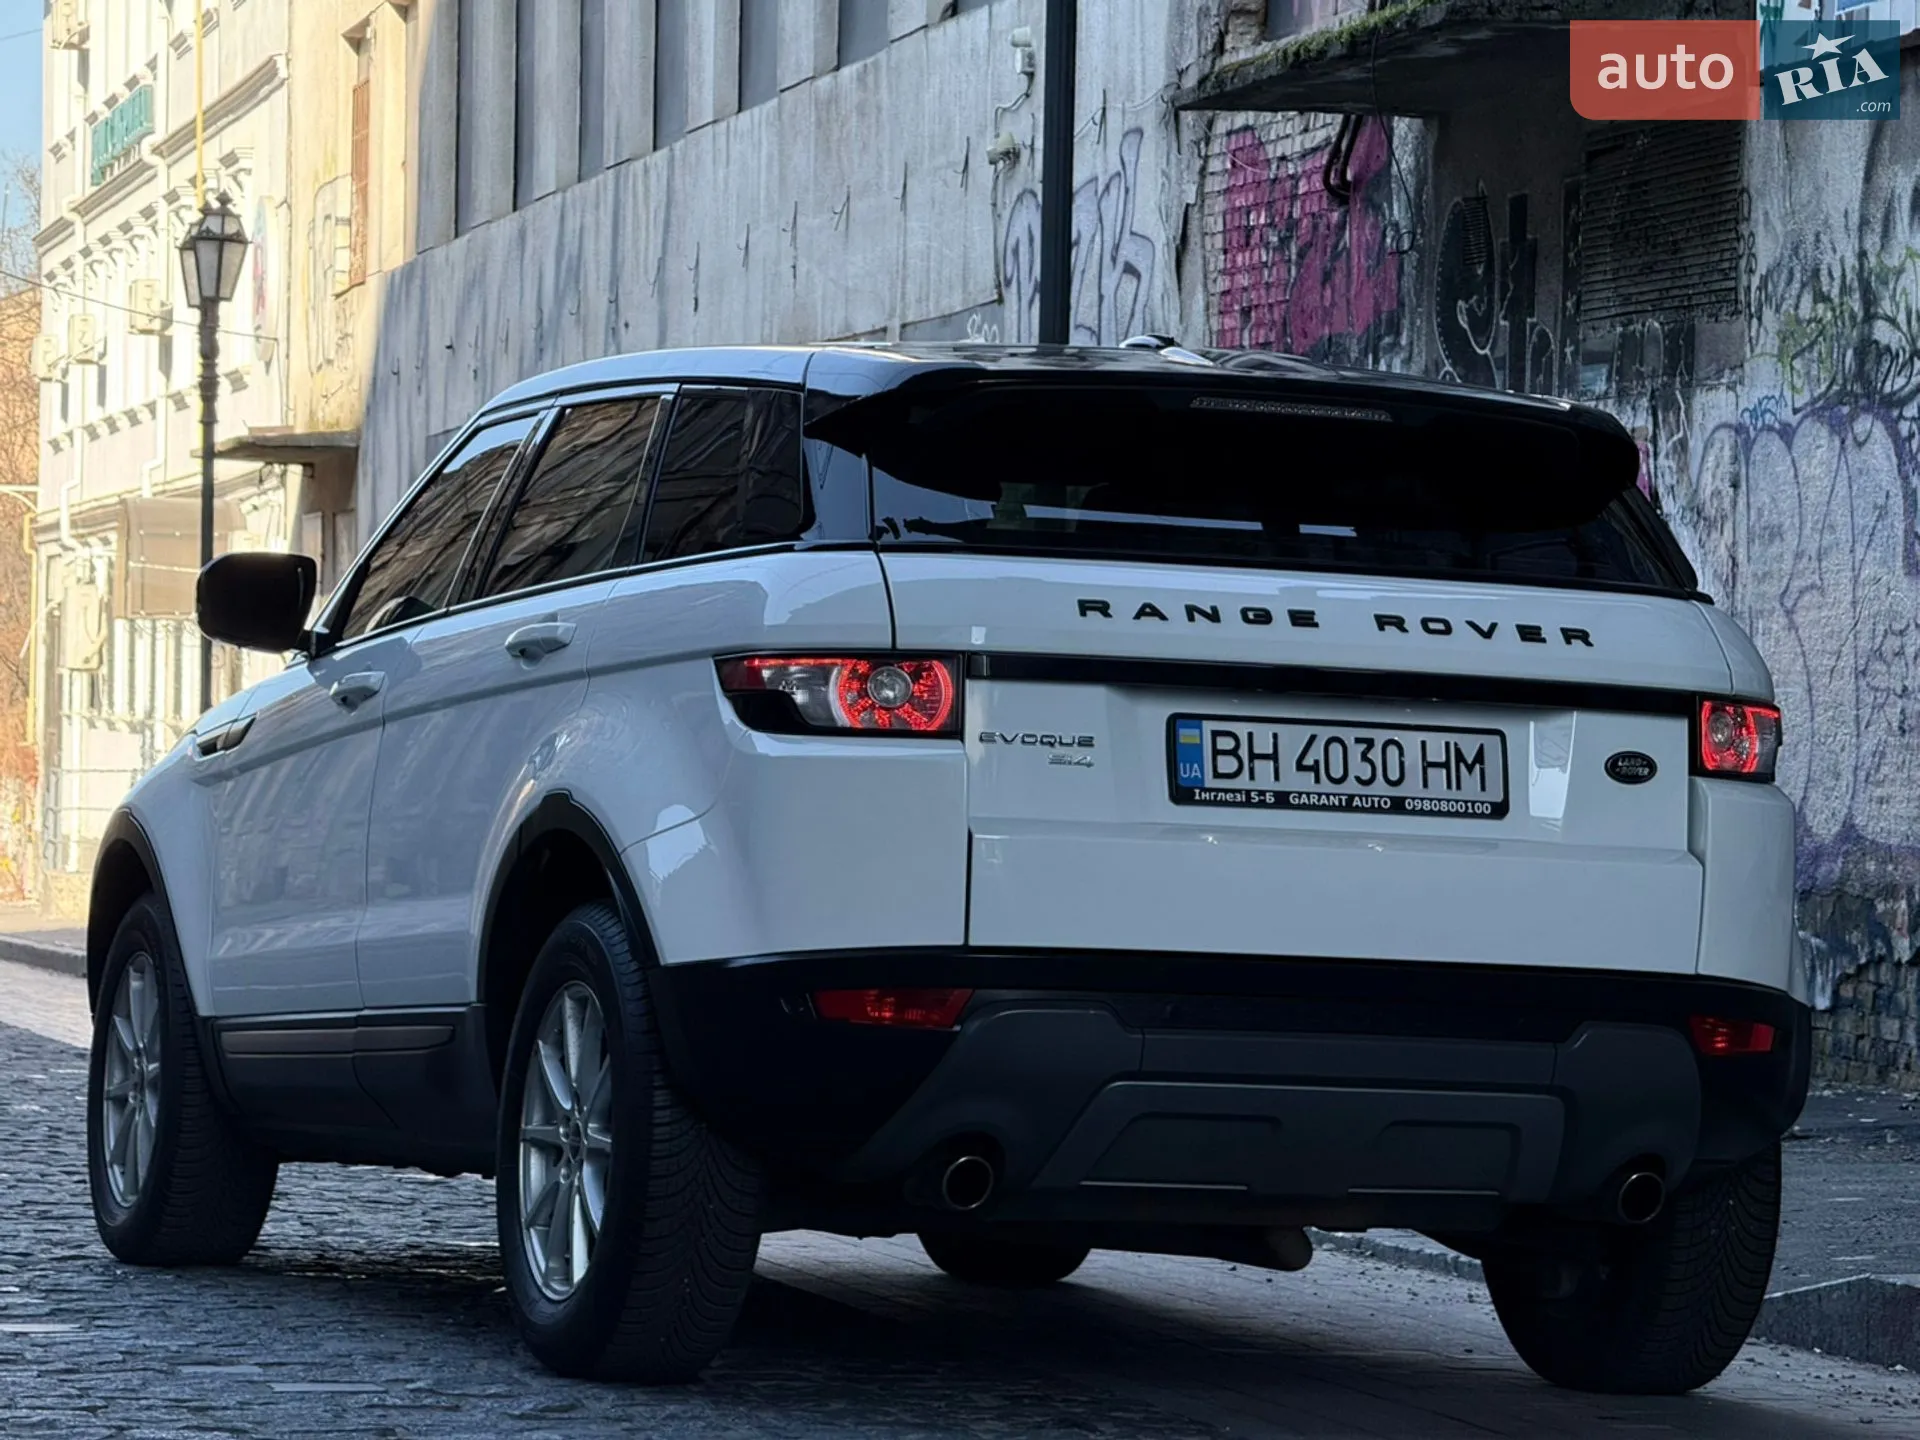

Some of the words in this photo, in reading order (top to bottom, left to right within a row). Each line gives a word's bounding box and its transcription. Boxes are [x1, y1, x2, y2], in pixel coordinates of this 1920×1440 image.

[1077, 598, 1320, 628] RANGE
[1373, 613, 1595, 648] ROVER
[978, 731, 1095, 748] EVOQUE
[1210, 729, 1281, 783] BH
[1294, 733, 1406, 788] 4030
[1419, 739, 1487, 793] HM
[1179, 762, 1202, 779] UA
[1288, 794, 1349, 809] GARANT
[1351, 796, 1391, 810] AUTO
[1404, 798, 1492, 815] 0980800100
